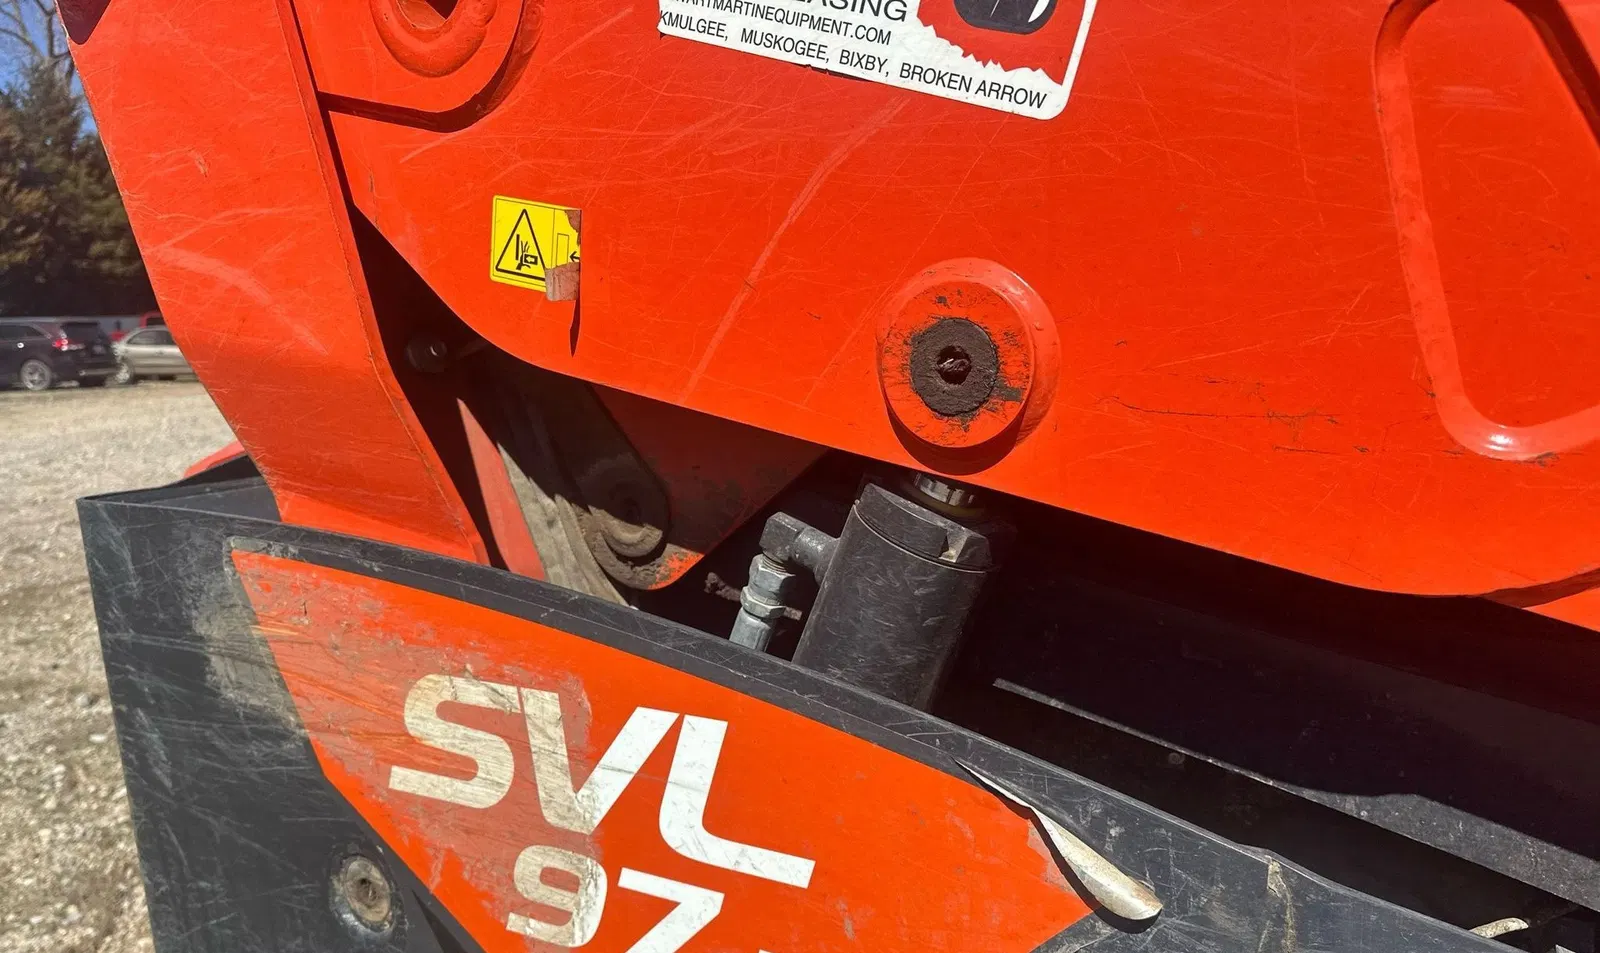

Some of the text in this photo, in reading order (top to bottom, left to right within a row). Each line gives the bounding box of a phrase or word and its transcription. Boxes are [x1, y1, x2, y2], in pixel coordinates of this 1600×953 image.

[740, 28, 830, 63] MUSKOGEE,
[839, 49, 889, 77] BIXBY,
[899, 62, 973, 92] BROKEN
[975, 80, 1047, 109] ARROW
[388, 673, 816, 889] SVL
